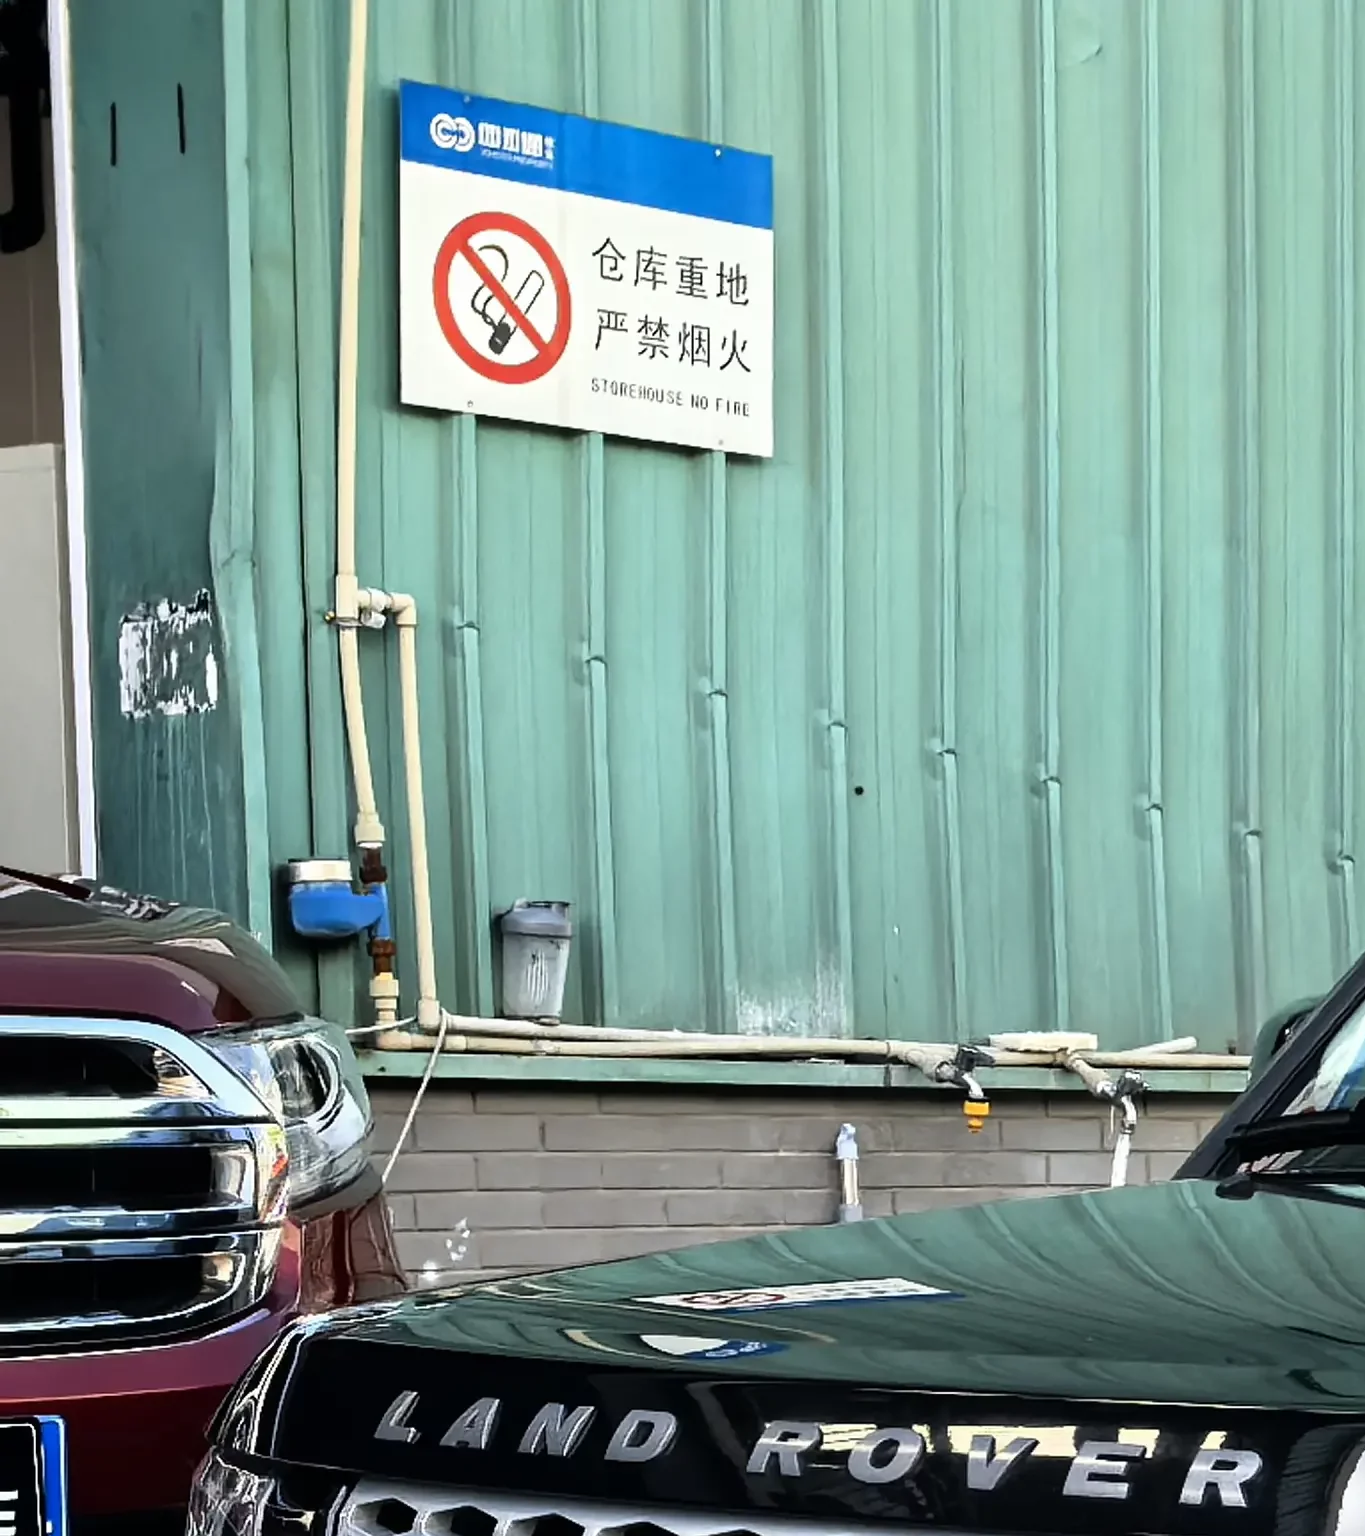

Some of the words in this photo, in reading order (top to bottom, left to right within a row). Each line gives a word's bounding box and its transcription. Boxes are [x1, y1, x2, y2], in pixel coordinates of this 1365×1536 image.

[592, 237, 750, 306] 仓库重地
[595, 309, 751, 373] 严禁烟火
[592, 377, 684, 407] STOREHOUSE
[691, 393, 709, 410] NO
[716, 398, 750, 417] FIRE
[373, 1390, 680, 1464] LAND
[747, 1420, 1263, 1509] ROVER
